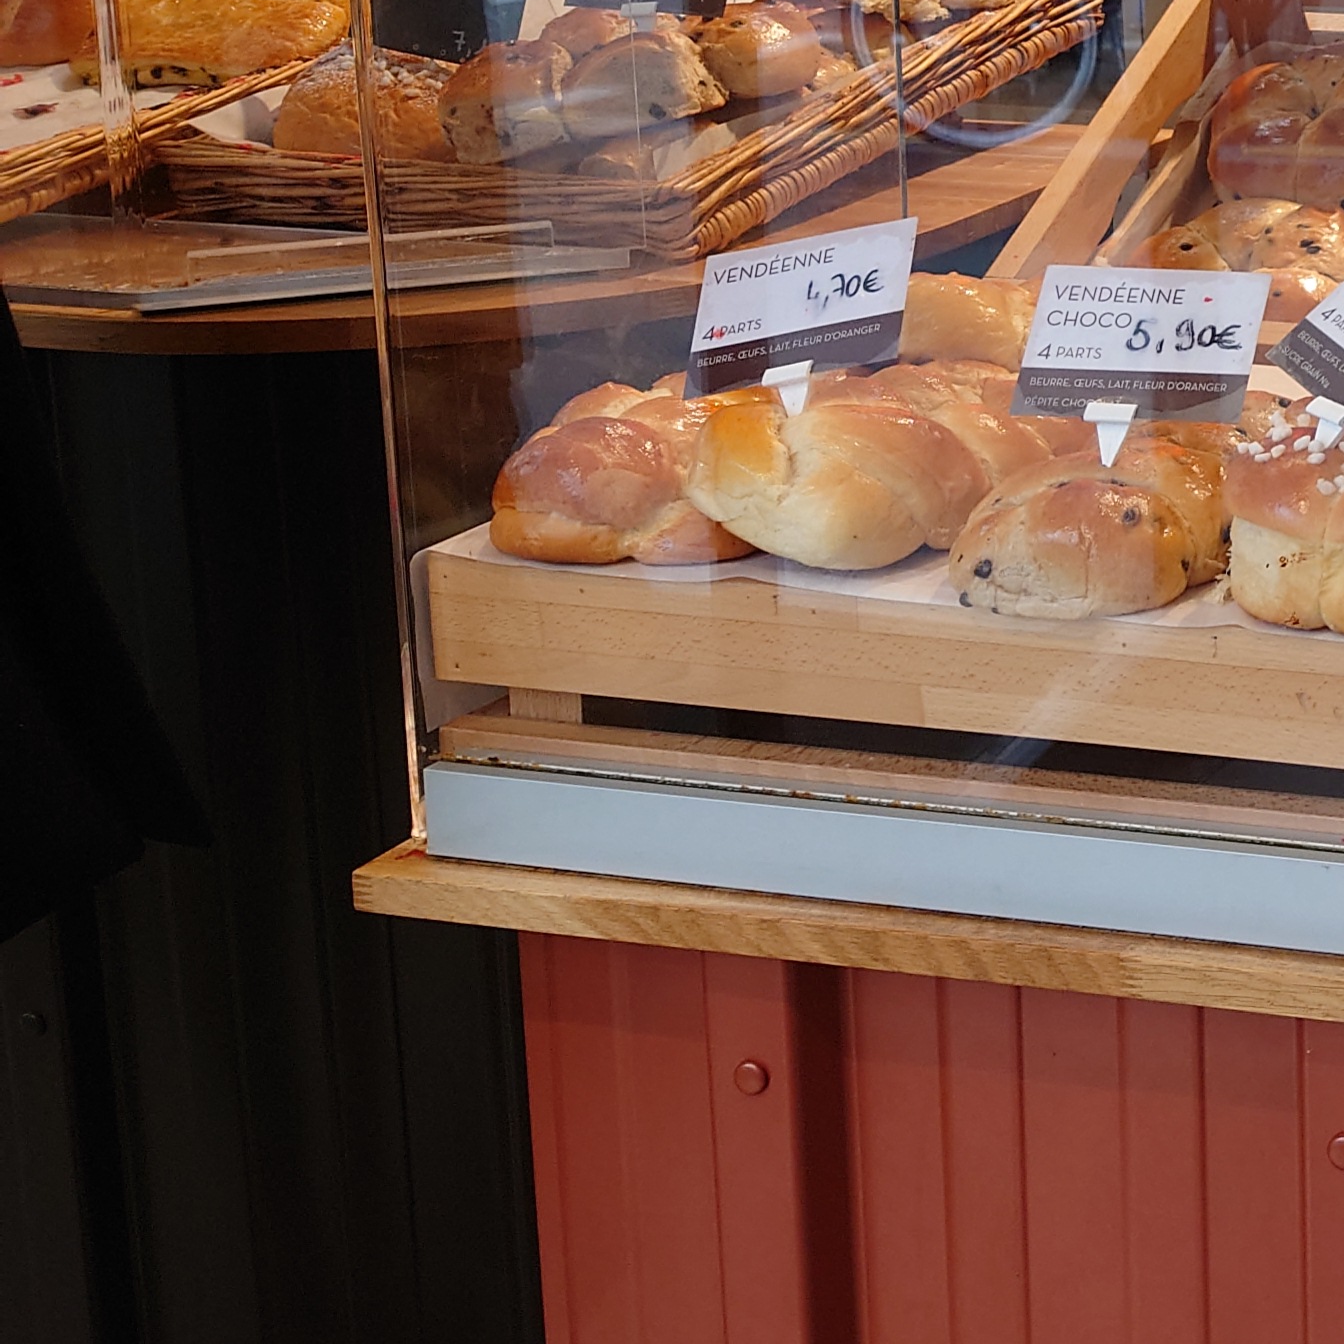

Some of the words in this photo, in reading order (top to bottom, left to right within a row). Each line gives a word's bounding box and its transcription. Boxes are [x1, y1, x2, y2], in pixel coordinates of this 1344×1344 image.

[713, 247, 836, 285] VENDÉENNE
[1055, 281, 1186, 305] VENDÉENNE
[1321, 308, 1336, 321] 4
[702, 325, 715, 341] 4
[721, 318, 762, 335] PARTS
[792, 335, 822, 349] FLEUR
[824, 323, 881, 343] D'ORANGER
[1047, 309, 1132, 329] CHOCO
[1125, 317, 1243, 354] 5,90€
[1037, 343, 1051, 360] 4
[1056, 346, 1102, 360] PARTS
[1133, 380, 1165, 392] FLEUR
[1167, 380, 1228, 393] D'ORANGER
[1024, 394, 1059, 407] PÉPITE
